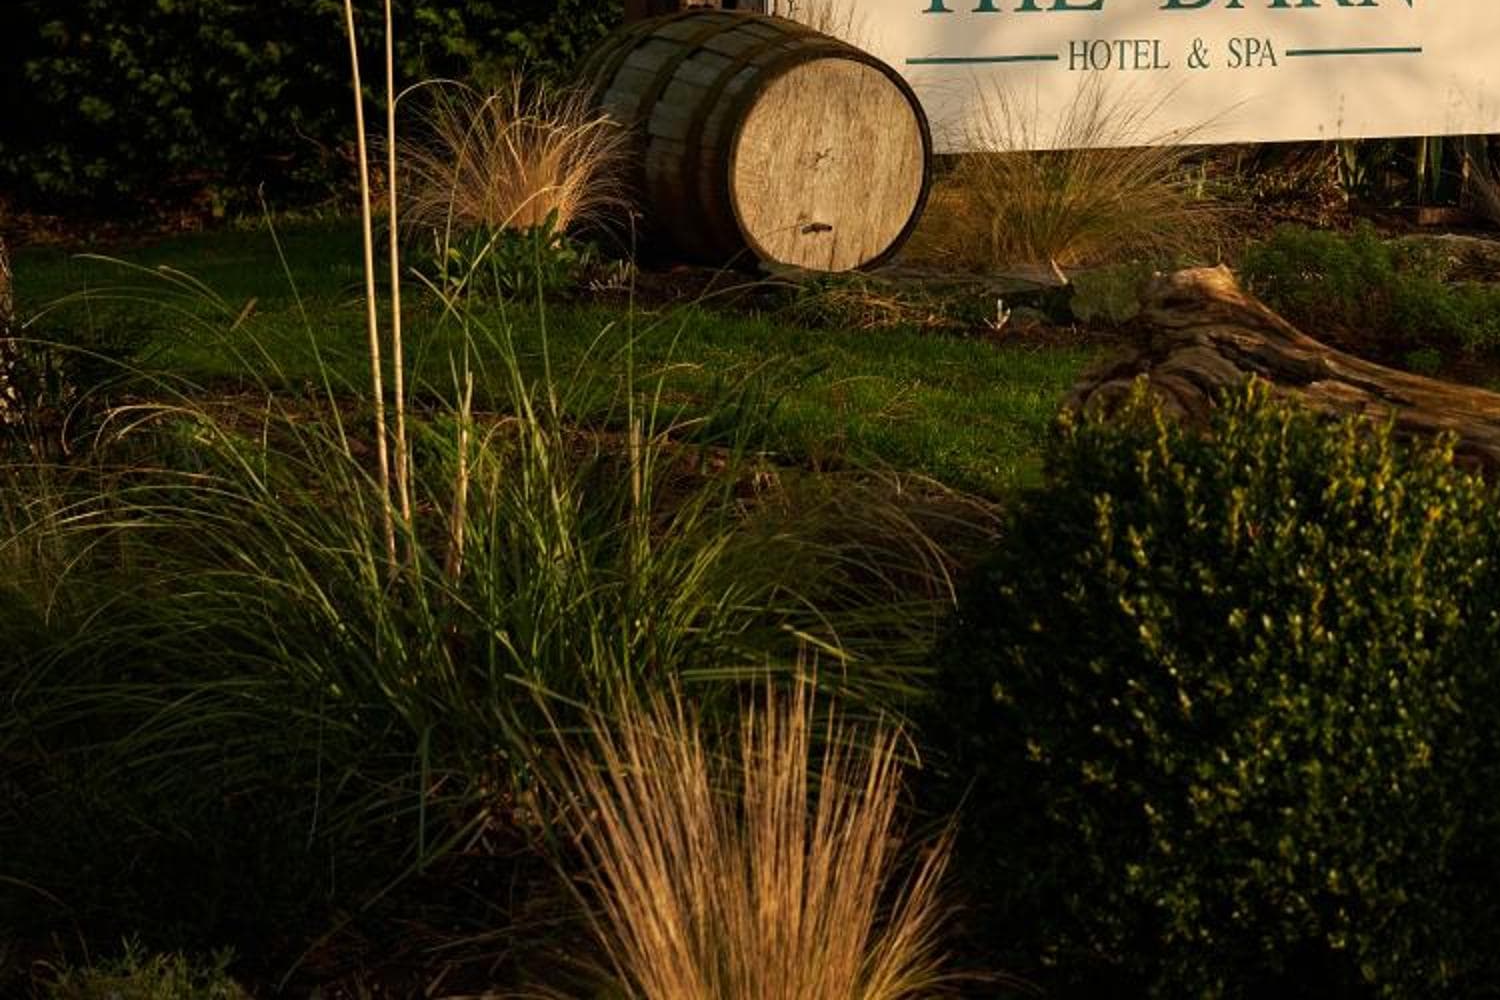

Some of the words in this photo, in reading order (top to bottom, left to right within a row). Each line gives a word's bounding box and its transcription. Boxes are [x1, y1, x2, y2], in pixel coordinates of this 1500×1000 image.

[1068, 38, 1171, 71] HOTEL
[1186, 37, 1211, 70] &
[1227, 37, 1278, 69] SPA
